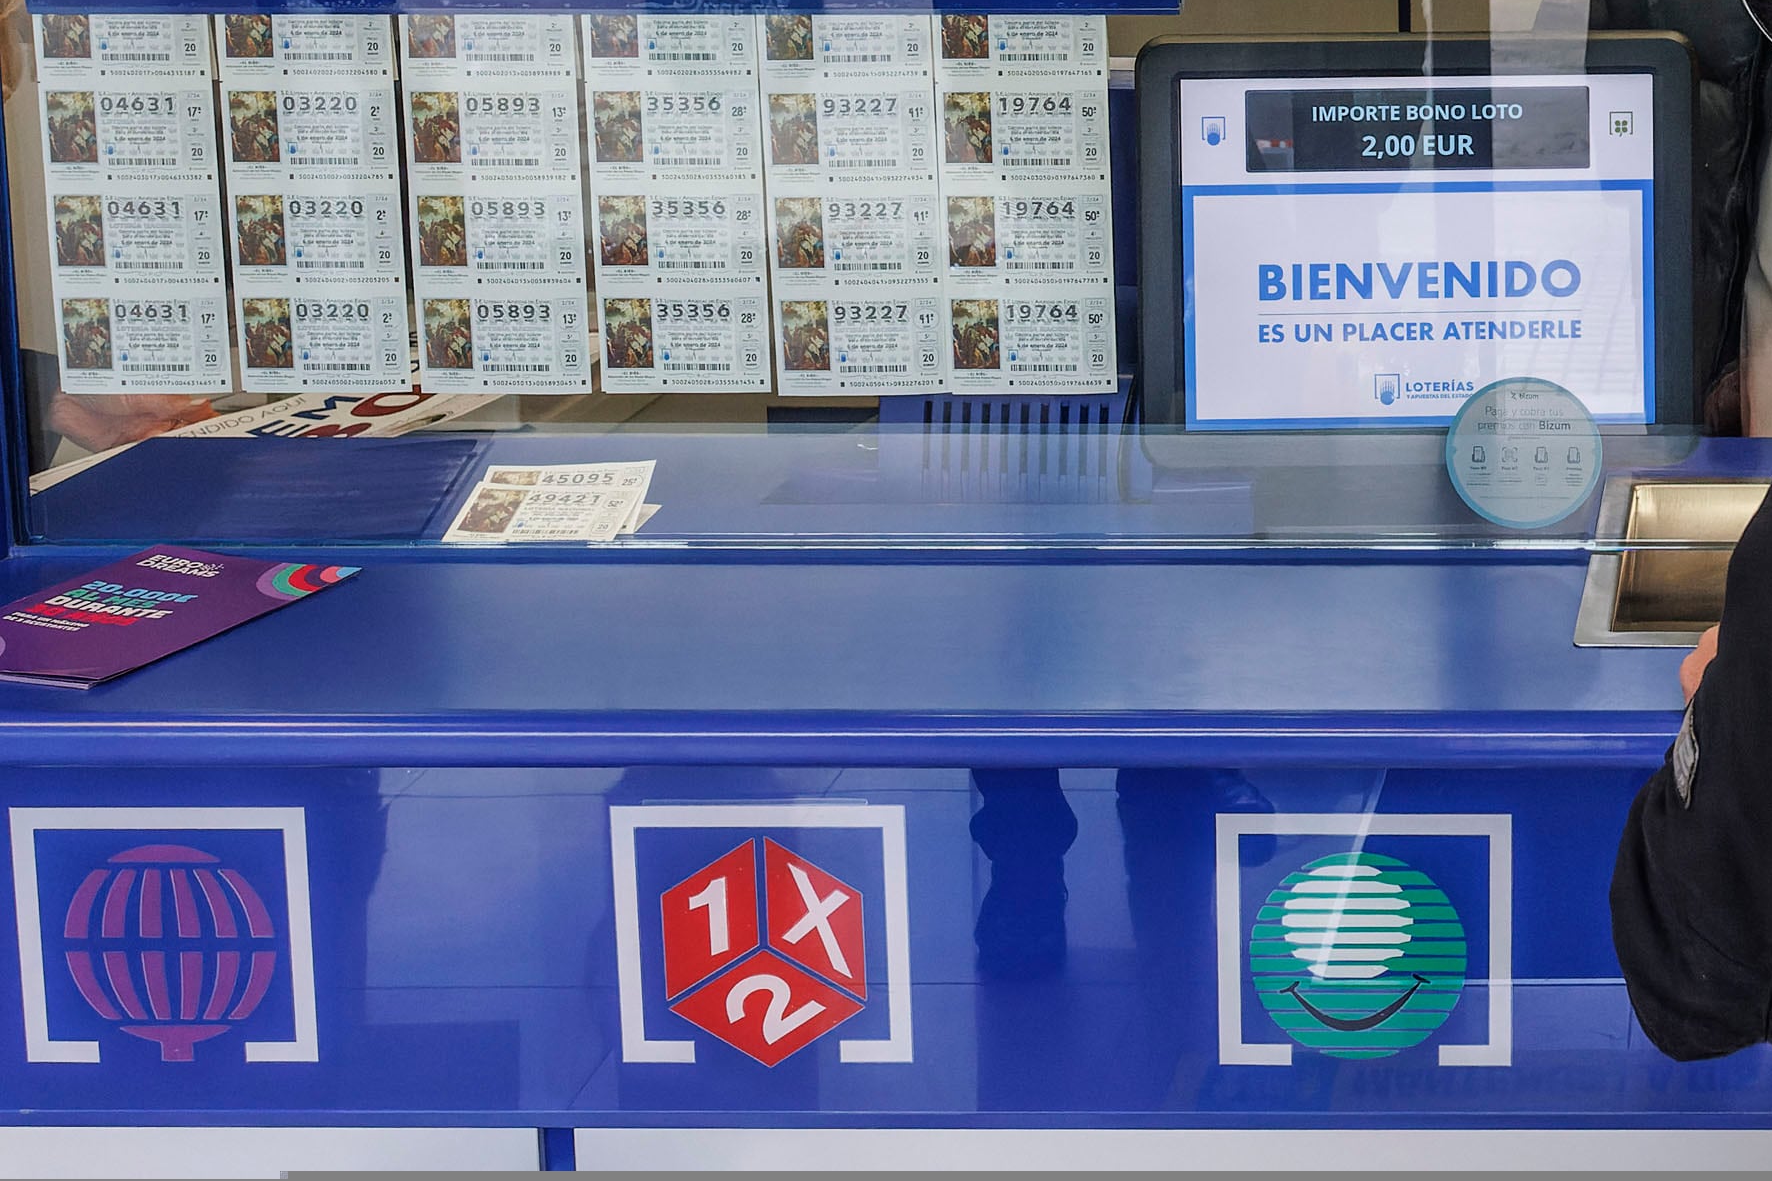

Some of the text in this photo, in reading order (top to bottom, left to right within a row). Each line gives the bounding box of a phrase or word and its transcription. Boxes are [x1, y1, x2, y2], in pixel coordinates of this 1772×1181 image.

[100, 95, 175, 114] 04631
[282, 96, 358, 113] 03220
[647, 97, 722, 114] 35356
[1311, 103, 1523, 123] IMPORTE BONO LOTO
[1361, 134, 1475, 159] 2,00 EUR
[1257, 259, 1582, 302] BIENVENIDO
[477, 303, 551, 320] 05893
[834, 304, 909, 321] 93227
[1005, 304, 1079, 321] 19764
[1258, 320, 1583, 343] ES UN PLACER ATENDERLE
[1406, 379, 1474, 392] LOTERÍAS
[542, 472, 615, 484] 45095
[529, 494, 601, 504] 49421
[136, 559, 220, 578] DREAMS
[148, 554, 204, 569] EURO
[44, 596, 174, 619] DURANTE
[63, 588, 161, 609] AL MES
[688, 876, 730, 956] 1
[782, 862, 855, 980] X
[726, 973, 826, 1045] 2
